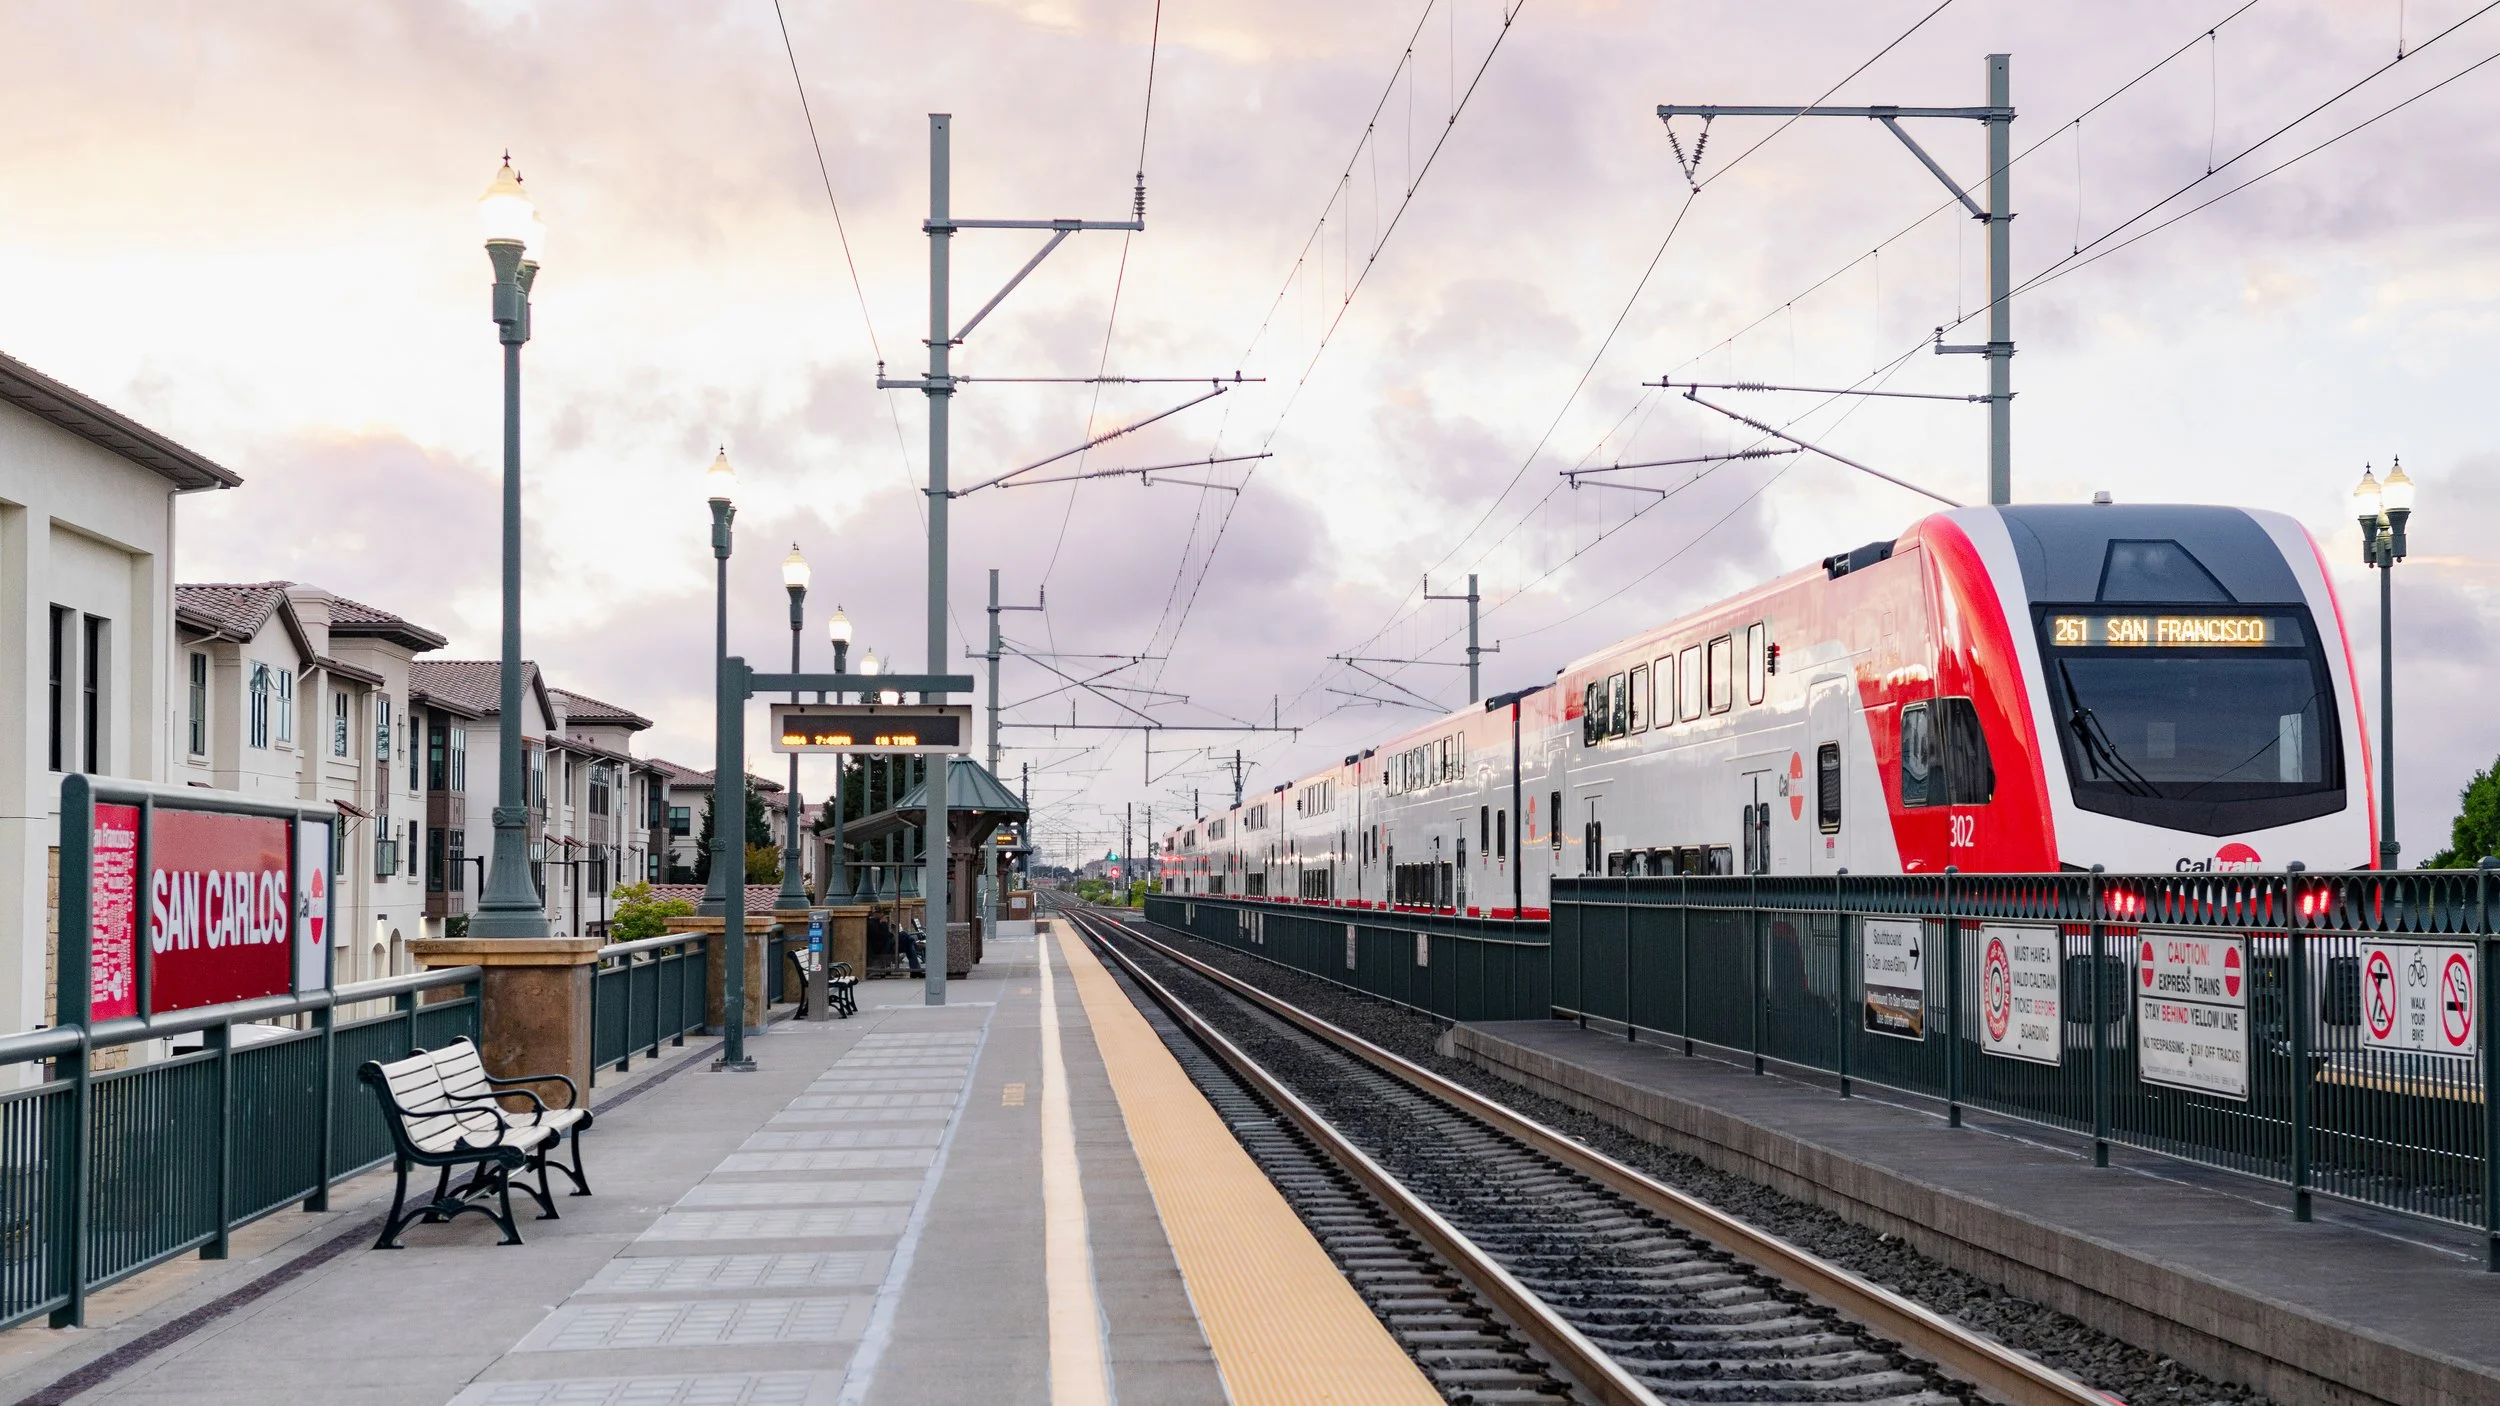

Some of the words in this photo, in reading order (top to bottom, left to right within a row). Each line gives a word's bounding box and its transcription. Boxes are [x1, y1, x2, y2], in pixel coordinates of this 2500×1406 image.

[2055, 619, 2087, 642] 261
[2107, 619, 2148, 642] SAN
[2157, 619, 2264, 642] FRANCISCO
[1950, 815, 1974, 847] 302
[152, 868, 199, 954] SAN
[205, 869, 286, 949] CARLOS
[1873, 929, 1902, 946] Southbound
[1866, 953, 1871, 969] To
[1872, 954, 1881, 970] San
[2014, 945, 2029, 961] MUST
[2031, 947, 2045, 963] HAVE
[2046, 948, 2051, 962] A
[2168, 941, 2210, 966] CAUTION!
[2013, 971, 2028, 987] VALID
[2030, 972, 2057, 990] CALTRAIN
[2159, 973, 2190, 993] EXPRESS
[2194, 976, 2220, 996] TRAINS
[2014, 997, 2033, 1014] TICKET
[2034, 1000, 2056, 1017] BEFORE
[2410, 996, 2425, 1010] WALK
[2145, 1002, 2160, 1021] STAY
[2162, 1004, 2189, 1024] BEHIND
[2190, 1007, 2219, 1028] YELLOW
[2221, 1011, 2238, 1031] LINE
[2411, 1012, 2425, 1026] YOUR
[2021, 1023, 2049, 1042] BOARDING
[2412, 1028, 2424, 1042] BIKE
[2143, 1036, 2150, 1049] NO
[2150, 1037, 2185, 1054] TRESPASSING
[2190, 1043, 2203, 1057] STAY
[2205, 1045, 2215, 1058] OFF
[2216, 1047, 2241, 1063] TRACKS!
